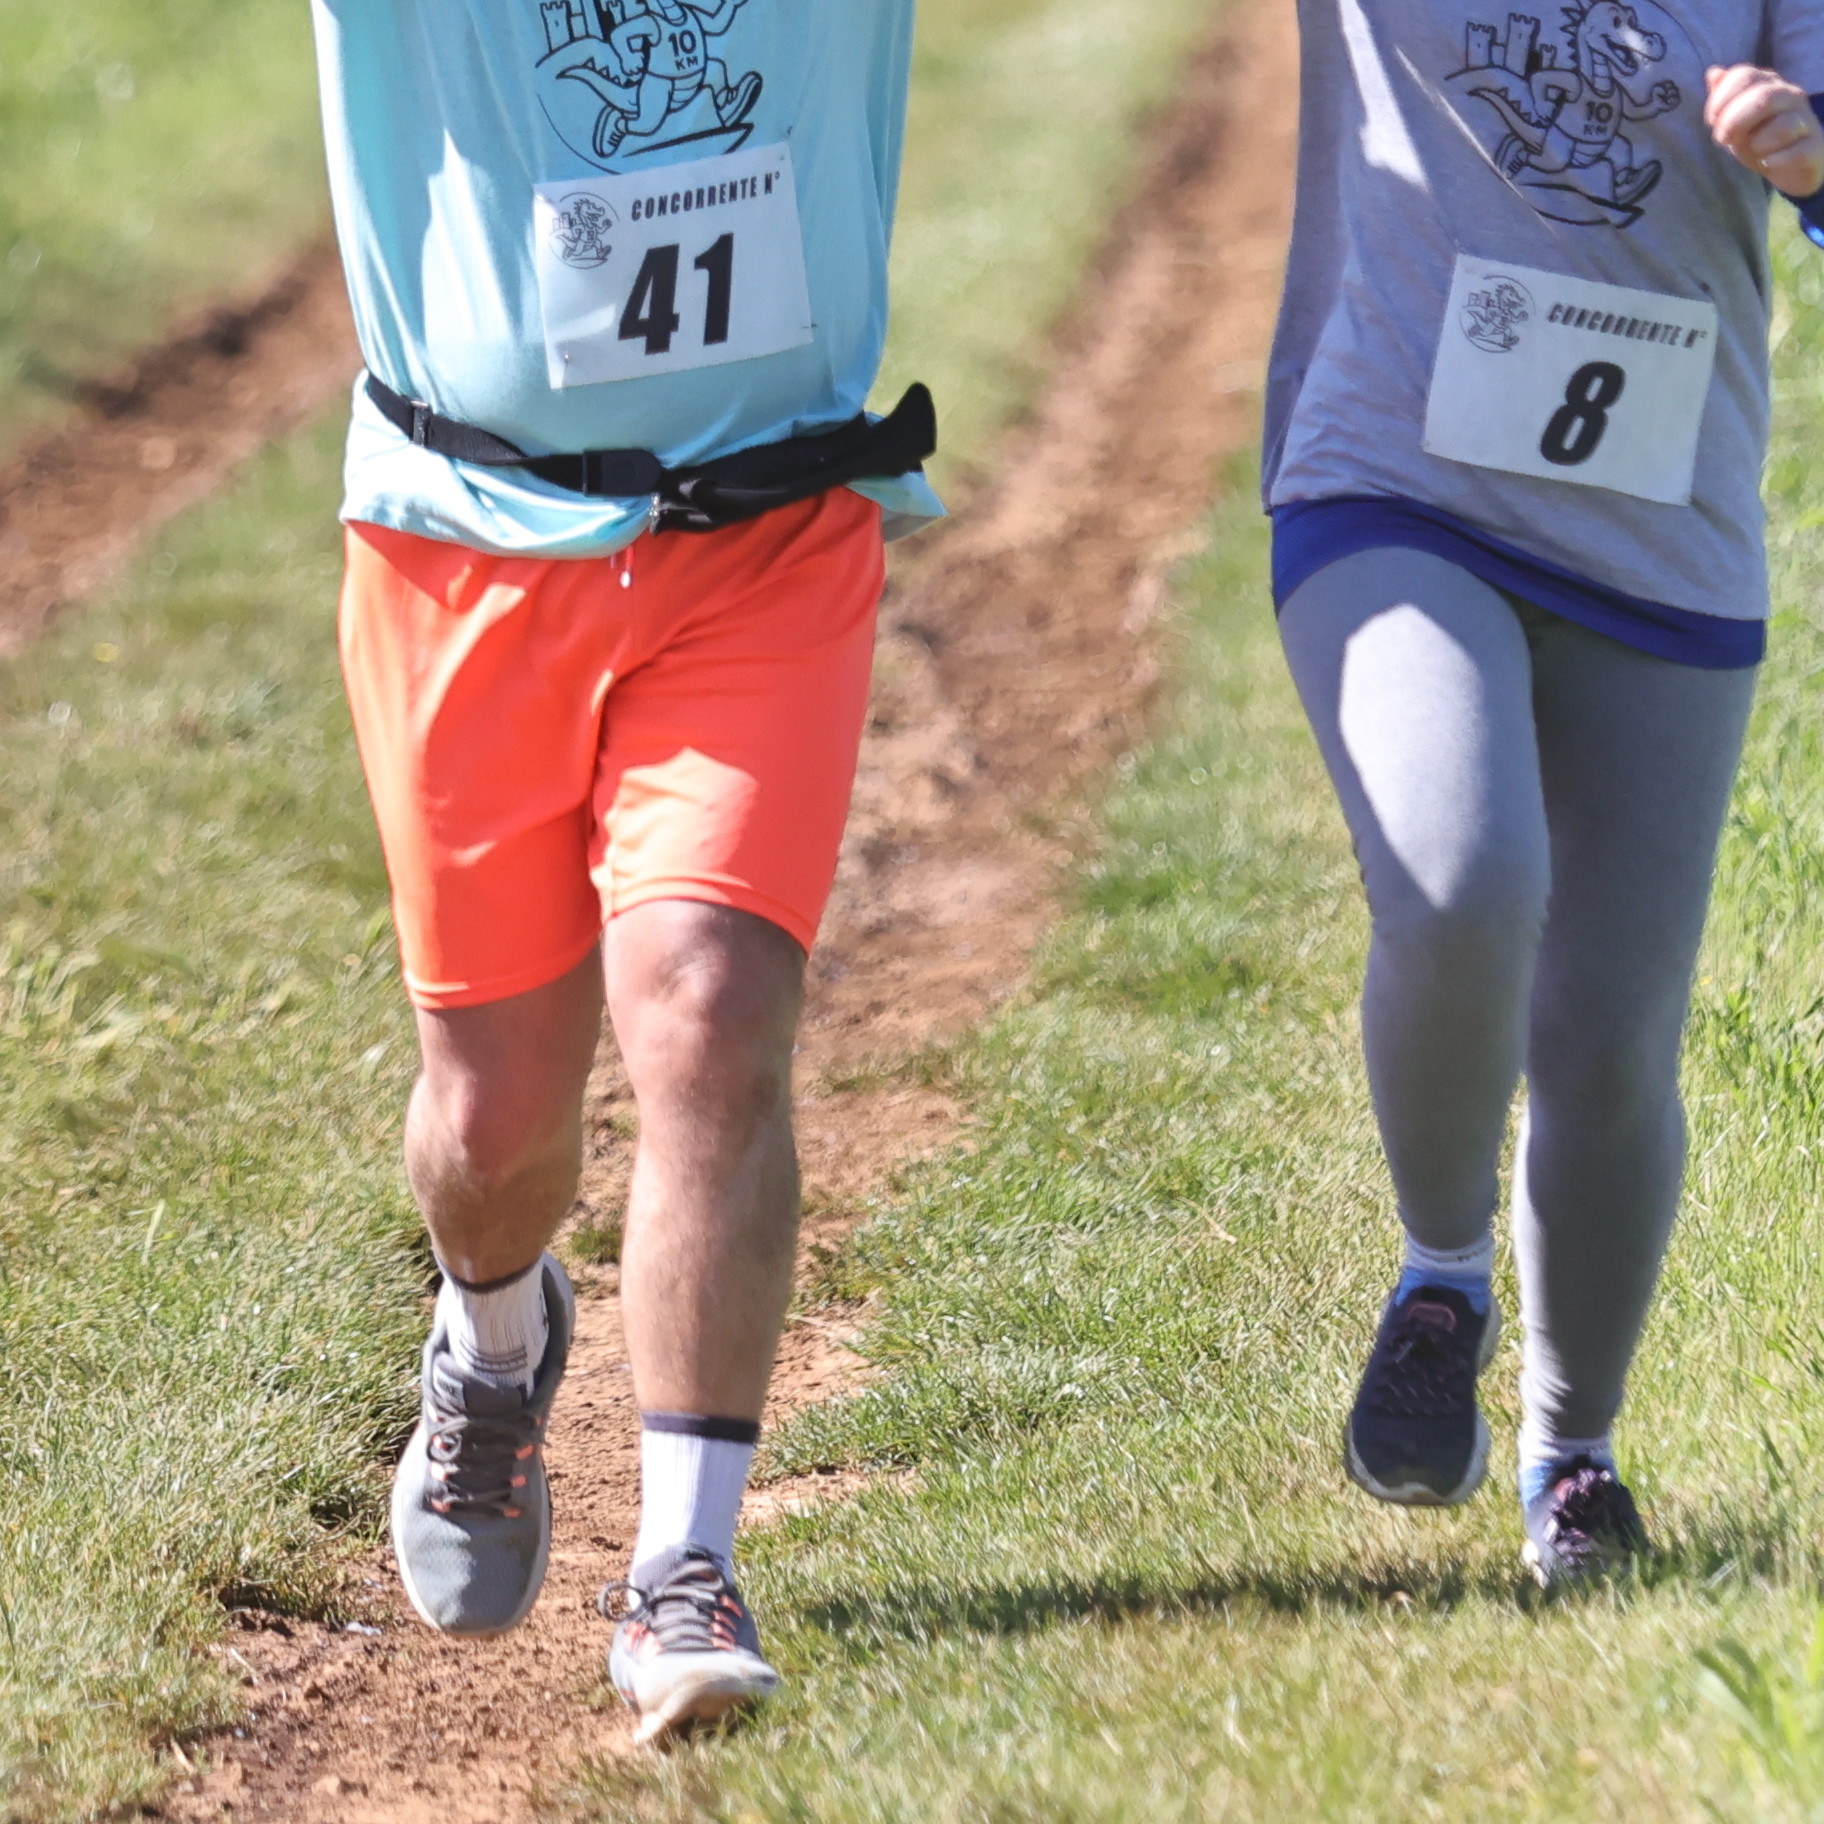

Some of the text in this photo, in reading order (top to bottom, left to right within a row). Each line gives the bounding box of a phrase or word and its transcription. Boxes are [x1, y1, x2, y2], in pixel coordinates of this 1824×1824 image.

[668, 29, 697, 58] 10
[675, 55, 699, 71] KM
[1586, 100, 1614, 124] 10
[1583, 124, 1608, 136] KM
[631, 176, 758, 222] CONCORRENTE
[617, 232, 735, 357] 41
[1540, 359, 1627, 467] 8
